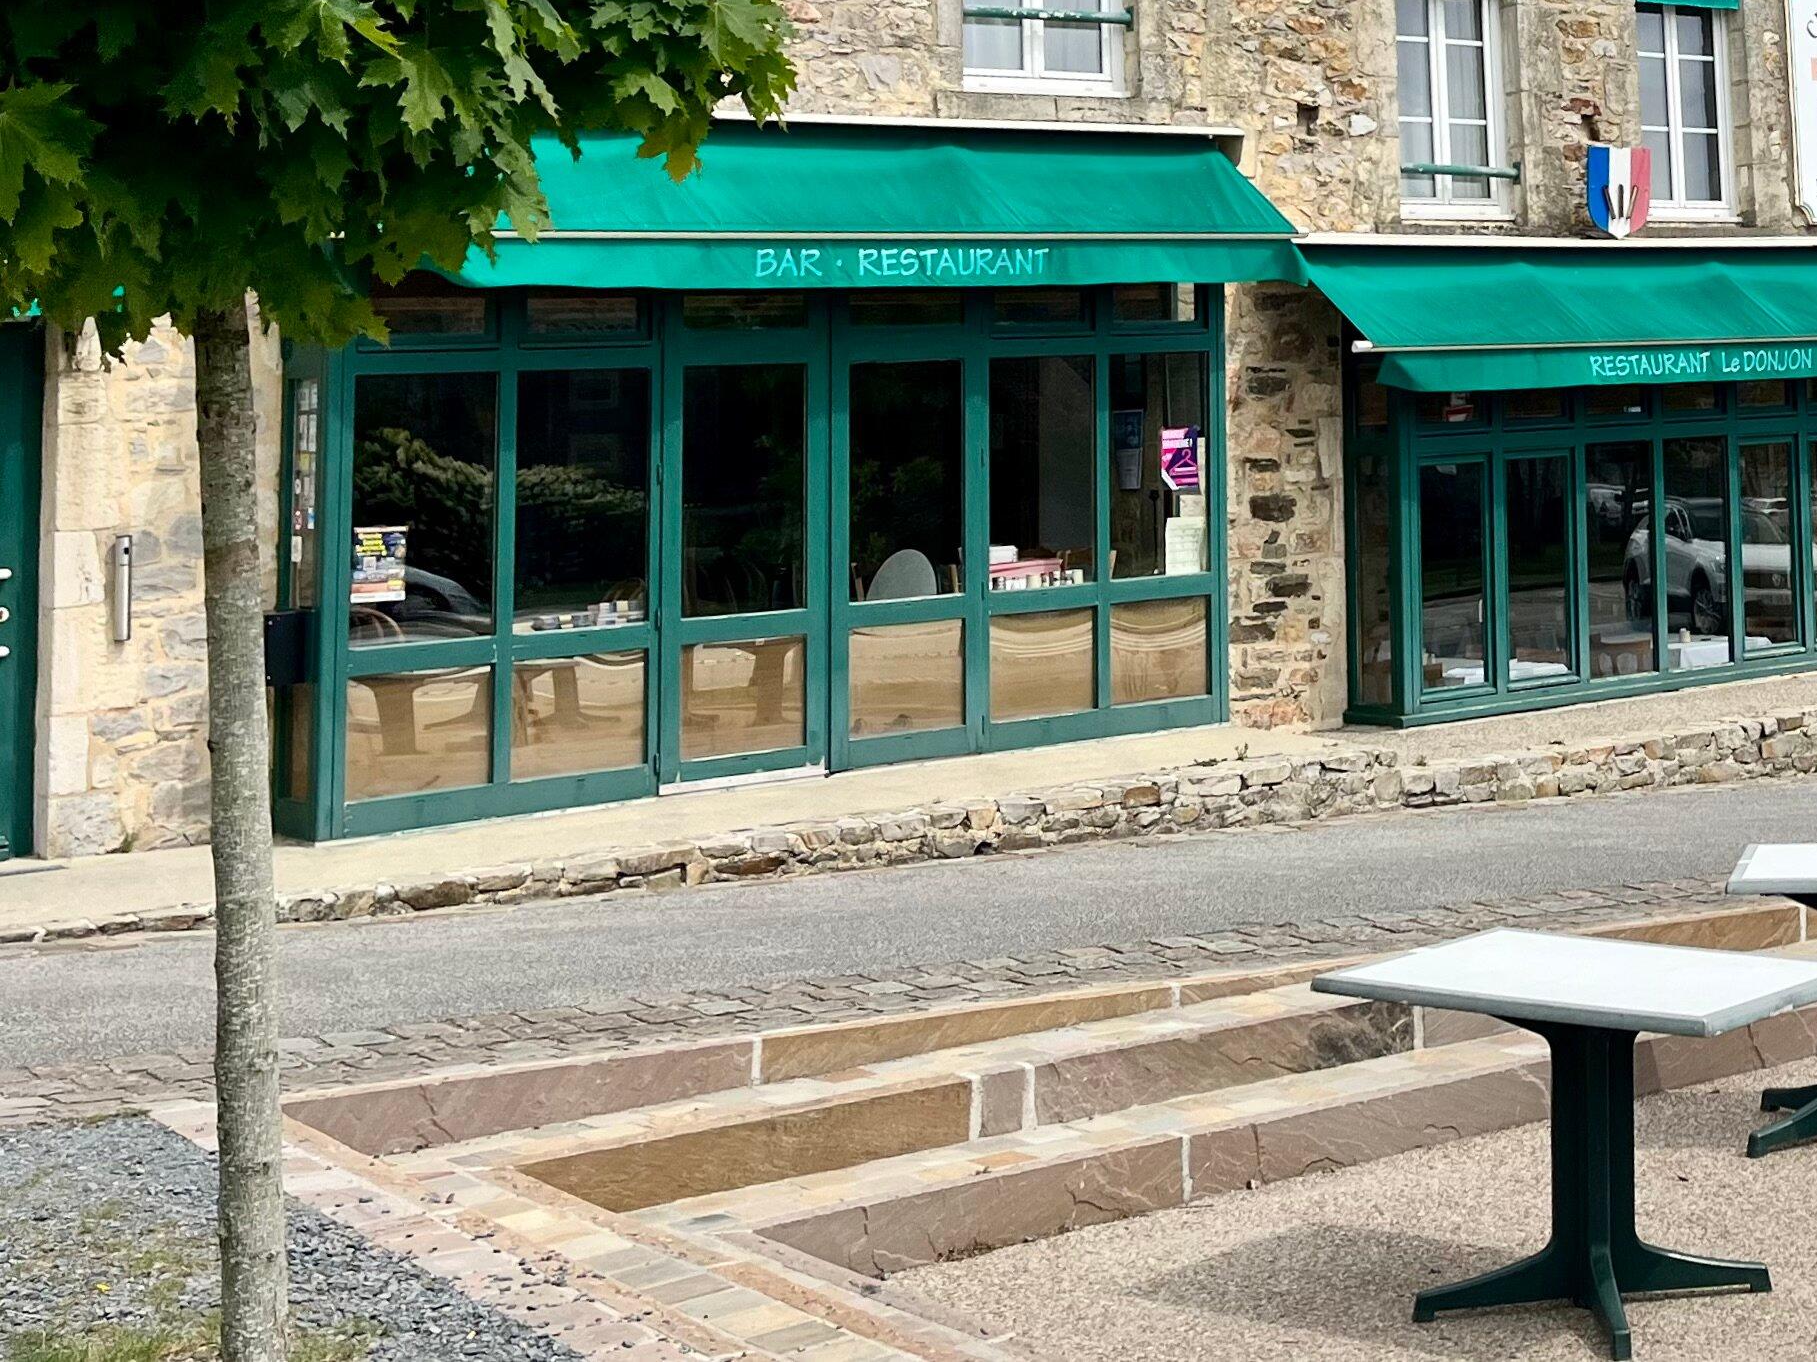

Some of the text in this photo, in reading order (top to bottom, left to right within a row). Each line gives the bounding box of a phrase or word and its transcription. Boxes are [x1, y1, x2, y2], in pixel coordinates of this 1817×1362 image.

[755, 248, 822, 277] BAR
[858, 247, 1050, 276] RESTAURANT
[1590, 348, 1813, 377] RESTAURANT Le DONJON
